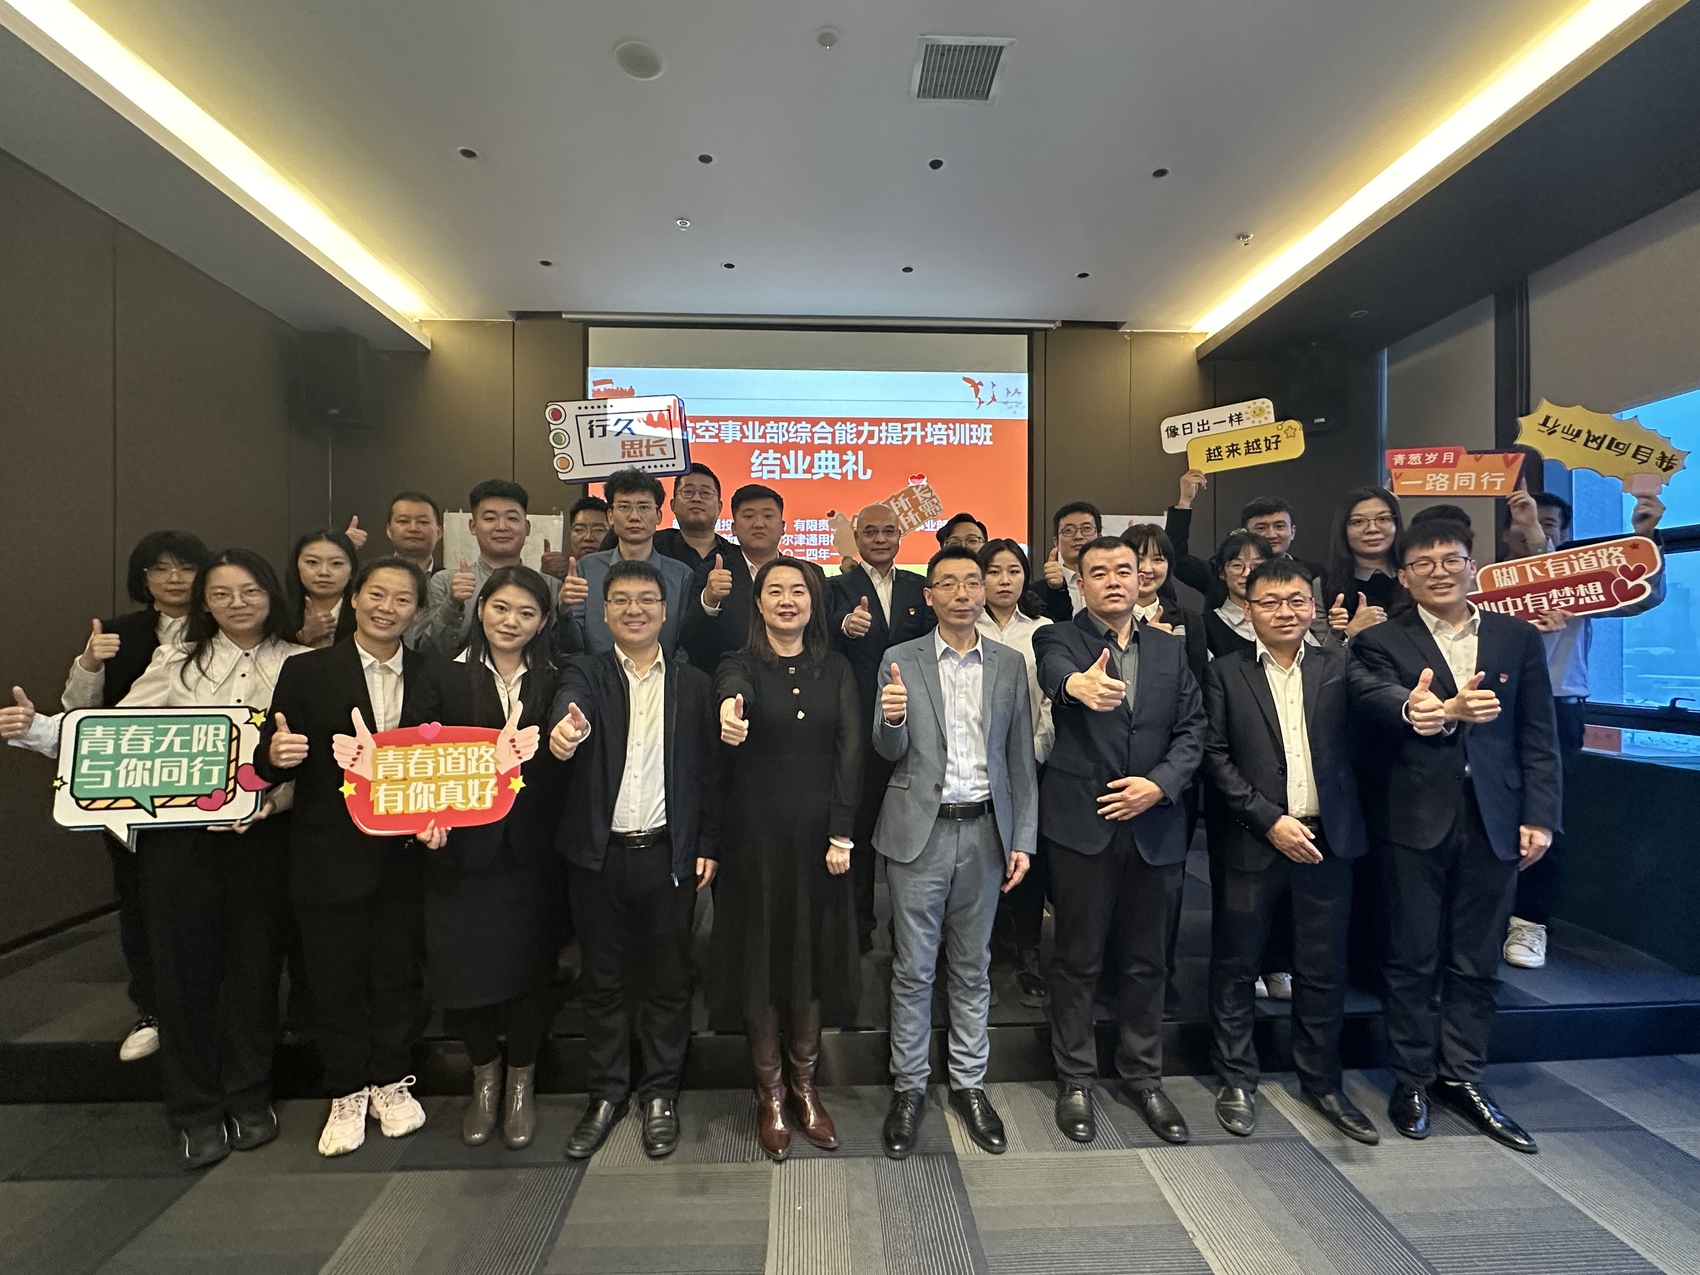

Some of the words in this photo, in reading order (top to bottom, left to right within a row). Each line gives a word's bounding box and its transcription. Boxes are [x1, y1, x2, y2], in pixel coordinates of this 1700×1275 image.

[588, 418, 636, 438] 行久
[1165, 412, 1243, 438] 像日出一样
[621, 438, 667, 458] 思长
[1205, 434, 1281, 462] 越来越好
[1538, 415, 1678, 472] 我自向风而行
[750, 450, 872, 480] 结业典礼
[1393, 452, 1455, 465] 青葱岁月
[1400, 472, 1505, 491] 一路同行
[778, 533, 835, 546] 尔津通用
[1492, 546, 1627, 588] 脚下有道路
[80, 724, 226, 755] 青春无限
[75, 757, 225, 789] 与你同行
[376, 746, 496, 779] 青春道路
[375, 778, 497, 813] 有你真好
